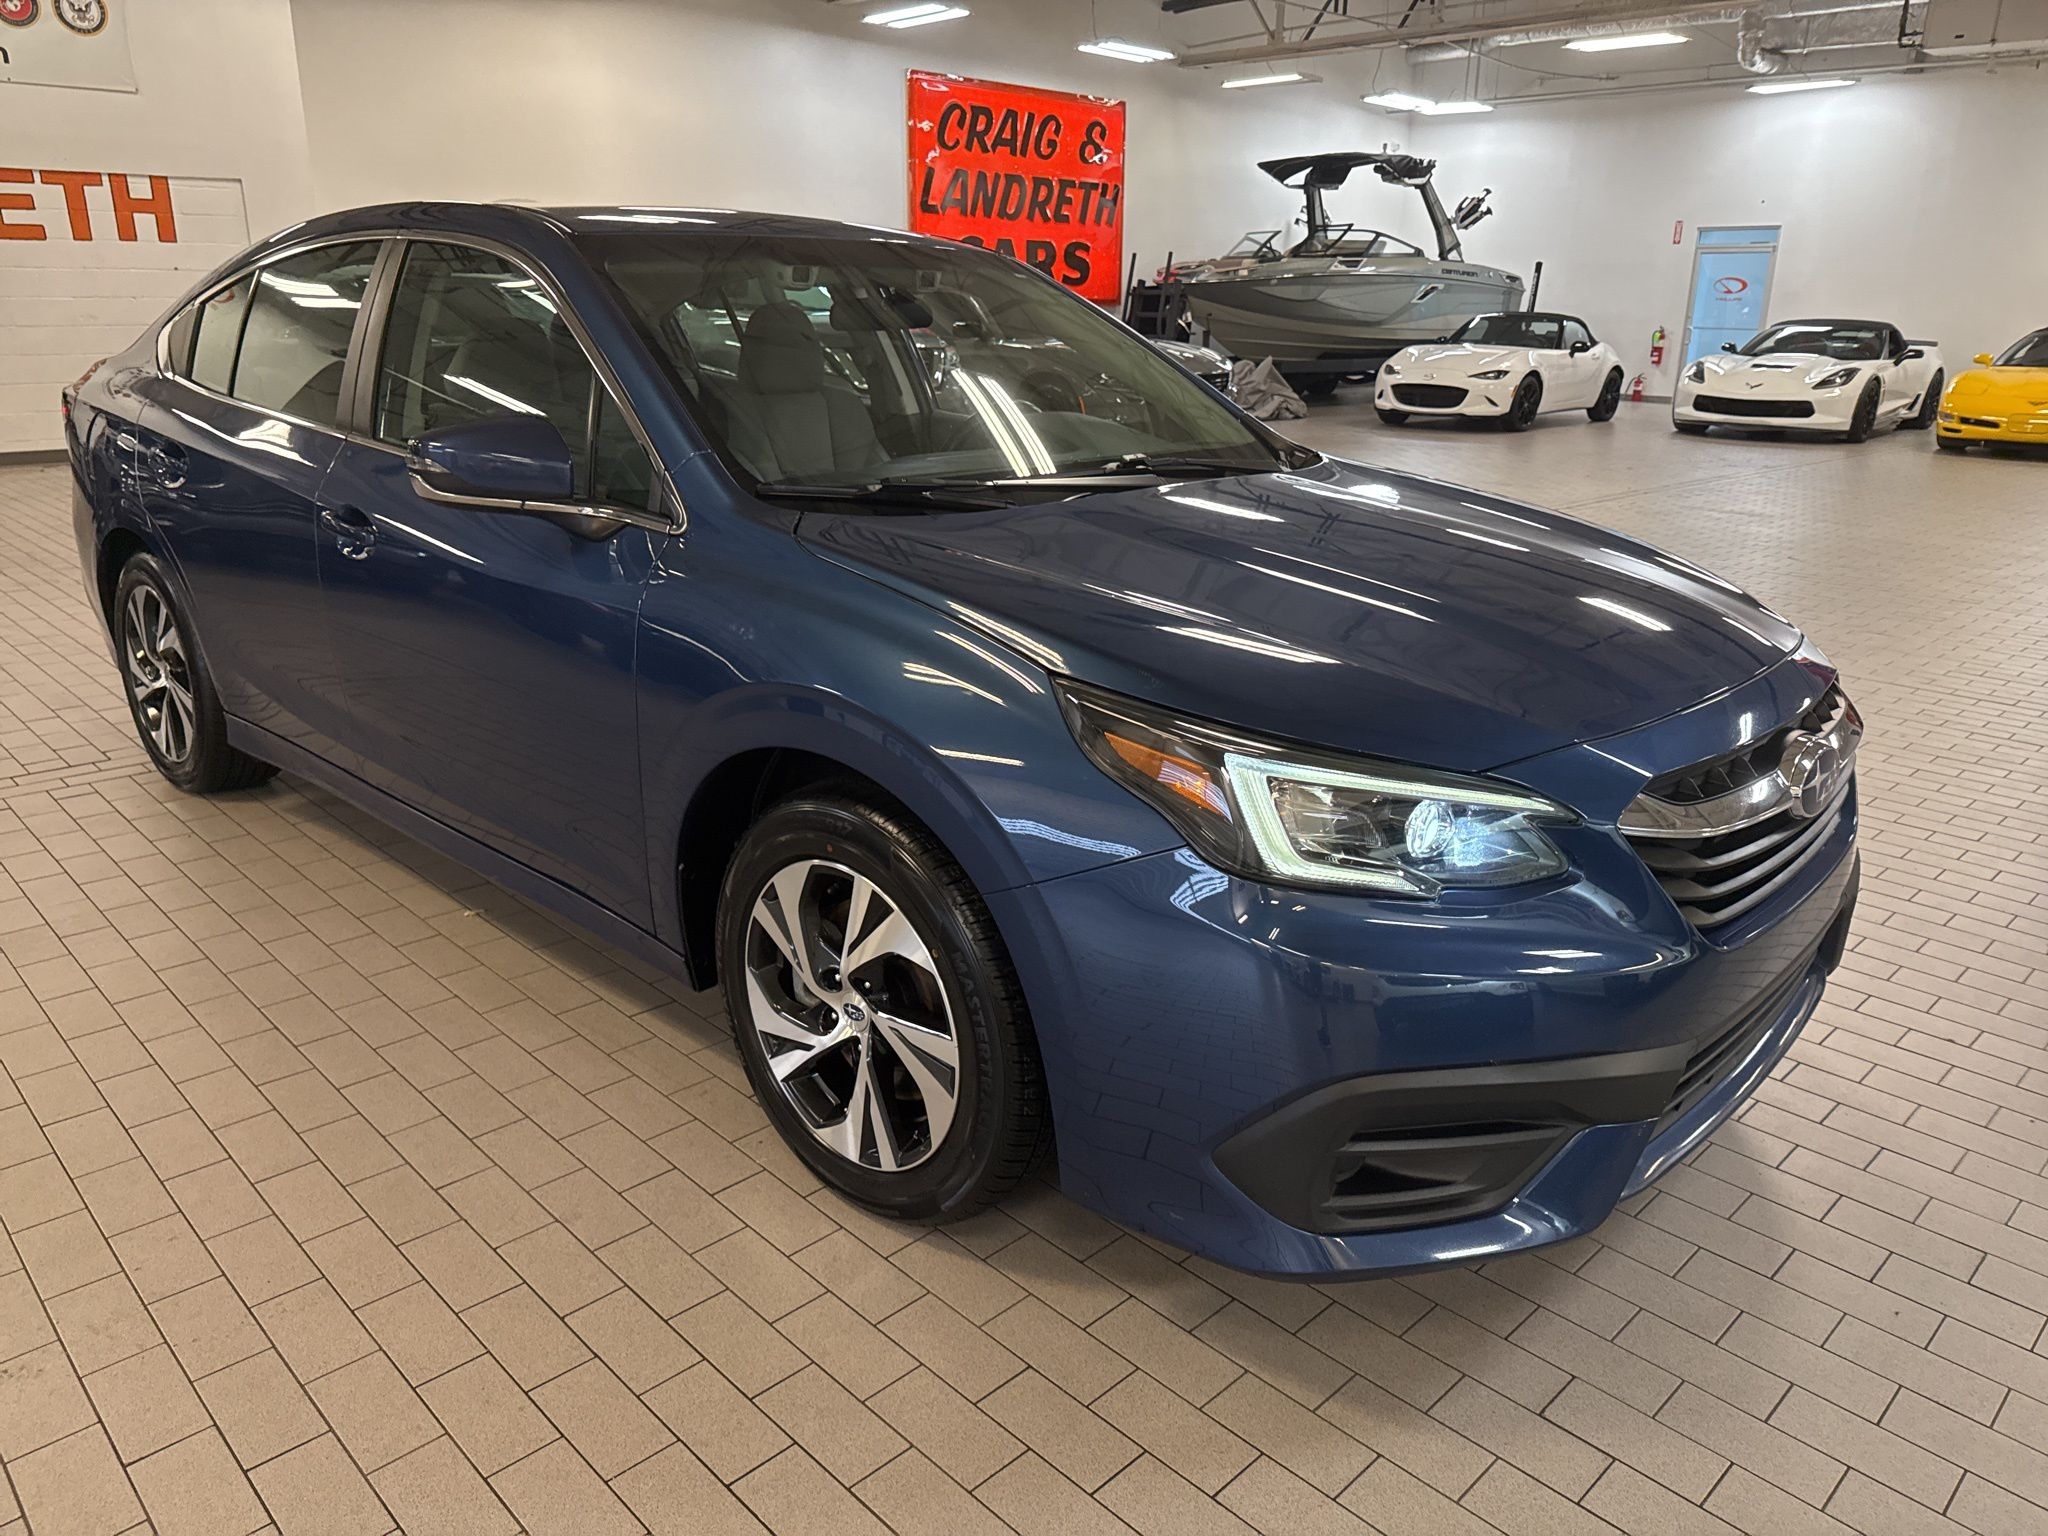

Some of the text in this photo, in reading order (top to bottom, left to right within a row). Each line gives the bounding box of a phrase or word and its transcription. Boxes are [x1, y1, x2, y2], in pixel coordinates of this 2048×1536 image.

[936, 102, 1109, 166] CRAIG &
[0, 168, 177, 243] ETH
[920, 166, 1121, 228] LANDRETH
